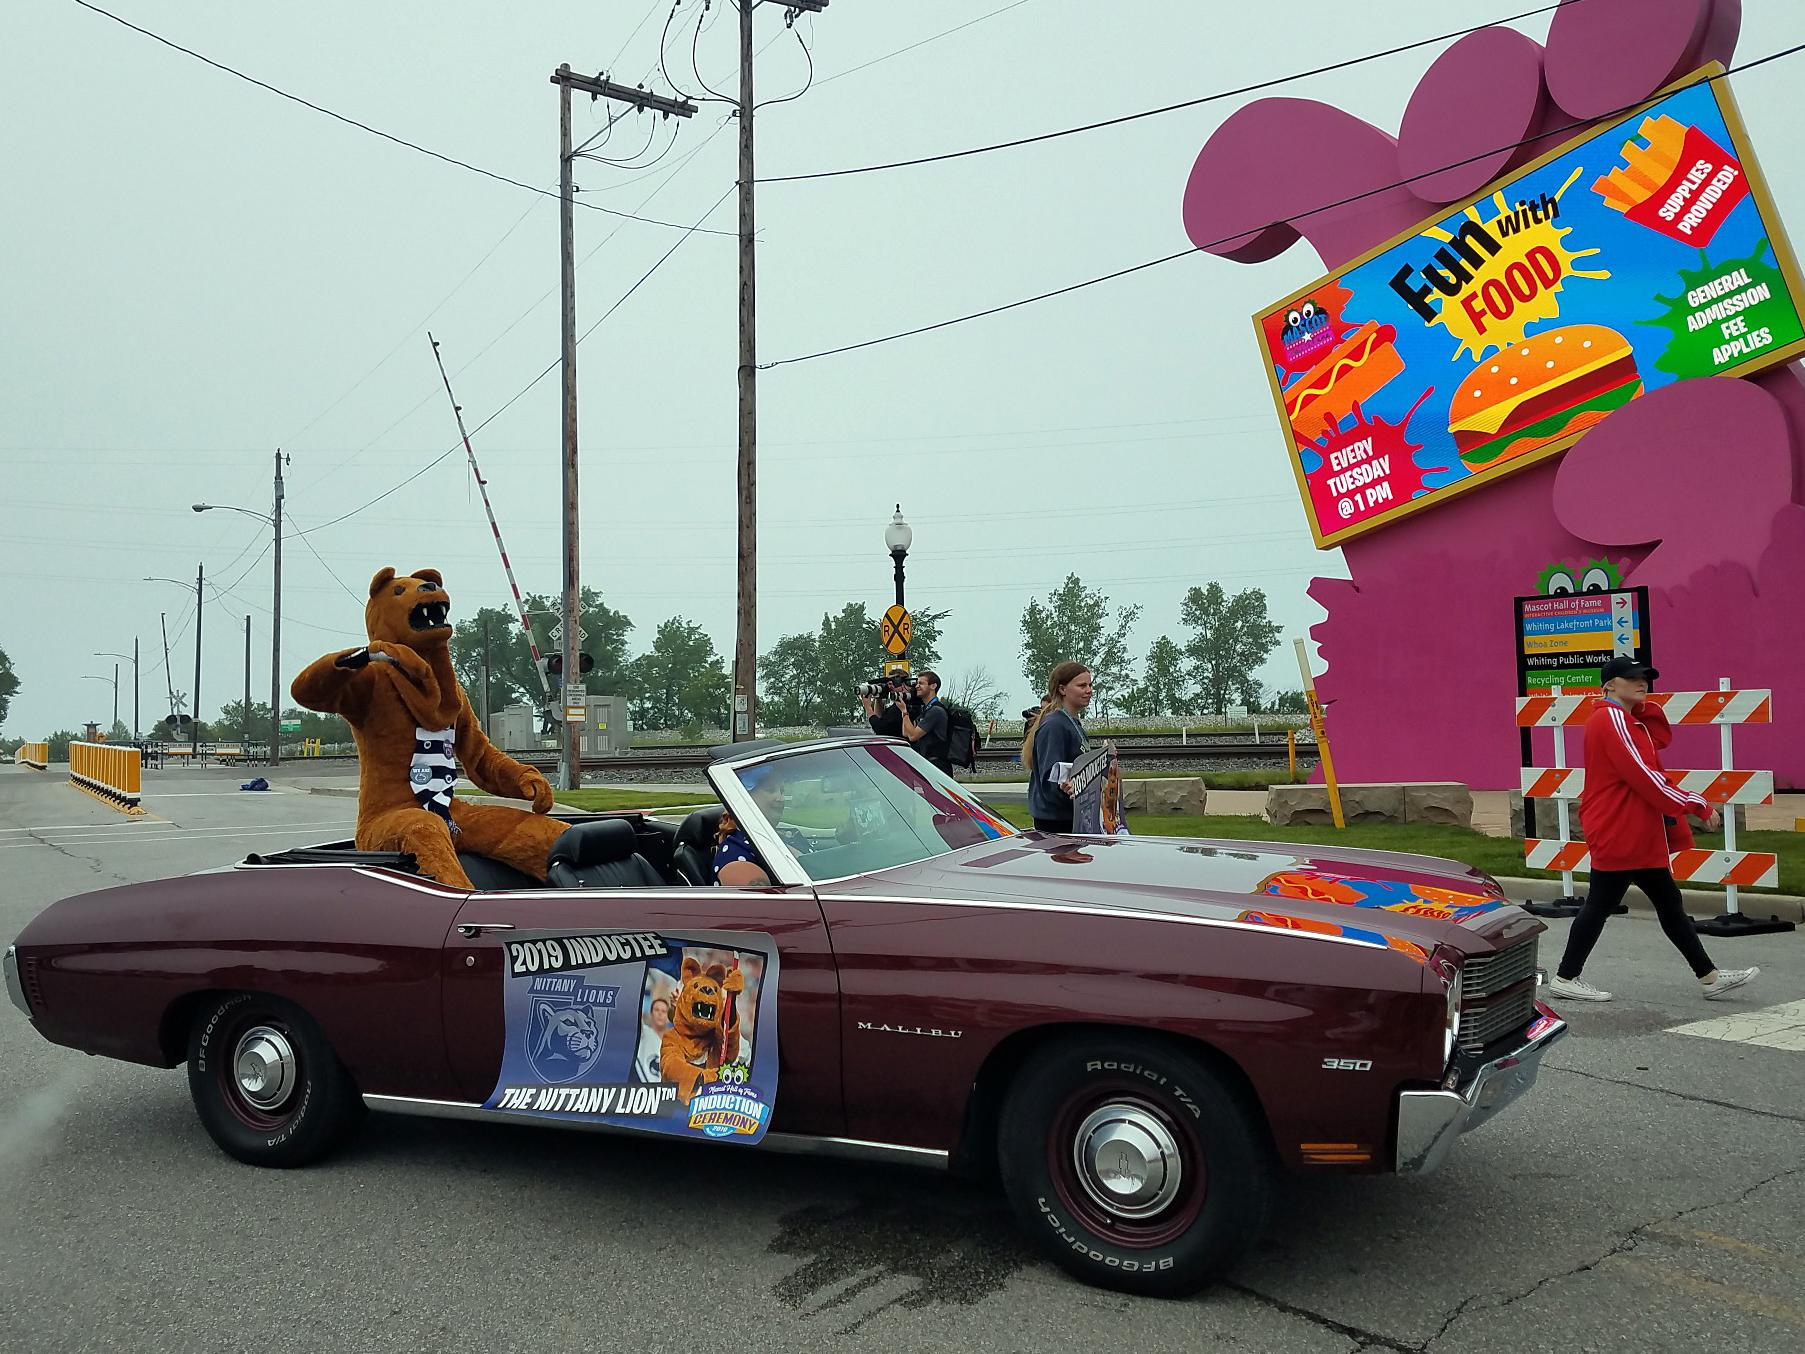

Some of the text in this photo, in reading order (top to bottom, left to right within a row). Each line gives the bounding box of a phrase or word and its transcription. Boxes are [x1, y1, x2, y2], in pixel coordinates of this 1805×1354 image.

[1658, 159, 1713, 221] SUPPLIES
[1677, 164, 1739, 235] PROVIDED!
[1388, 192, 1561, 324] Fun with
[1460, 245, 1562, 336] FOOD
[1687, 268, 1752, 307] GENERAL
[1686, 283, 1771, 332] ADMISSION
[1284, 314, 1328, 346] MASCOT
[1720, 316, 1748, 340] FEE
[1712, 327, 1773, 365] APPLIES
[1329, 436, 1373, 471] EVERY
[1326, 454, 1390, 496] TUESDAY
[1338, 481, 1393, 519] @ 1 PM
[1524, 599, 1602, 612] Mascot Hall of Fame
[883, 622, 910, 637] R R
[1525, 617, 1612, 632] Whiting Lakefront Park
[1549, 639, 1568, 648] Zone
[1526, 653, 1611, 667] Whiting Public Works
[1527, 674, 1593, 686] Recycling Center
[510, 932, 668, 973] 2019 INDUCTEE
[533, 977, 577, 992] NITTANY
[576, 988, 614, 1004] LIONS
[858, 1021, 962, 1038] MALIBU
[1321, 1058, 1373, 1071] 350
[497, 1087, 537, 1110] THE
[532, 1087, 617, 1114] NITTANY
[1086, 1060, 1201, 1119] Radial T/A
[692, 1094, 764, 1120] INDUCTION
[693, 1112, 756, 1131] CEREMONY
[1037, 1197, 1174, 1272] BFGoodrich
